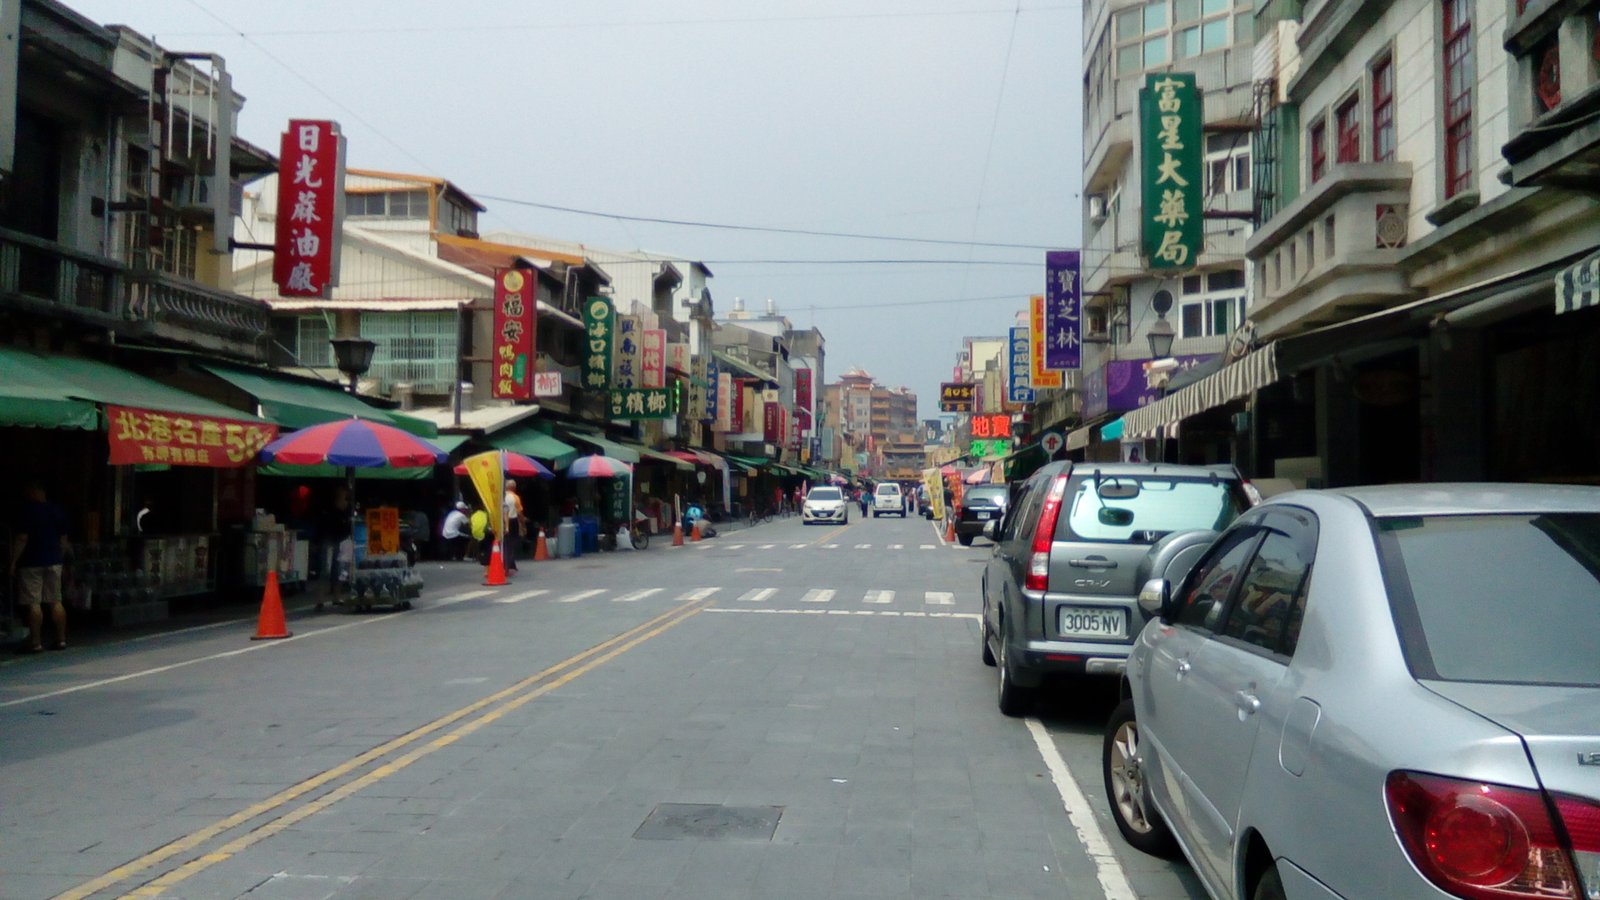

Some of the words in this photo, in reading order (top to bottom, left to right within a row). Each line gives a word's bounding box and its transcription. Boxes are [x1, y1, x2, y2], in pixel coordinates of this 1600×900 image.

[1153, 77, 1189, 265] 富星大藥局
[1057, 269, 1080, 349] 寶芝林
[115, 410, 224, 446] 北港名產
